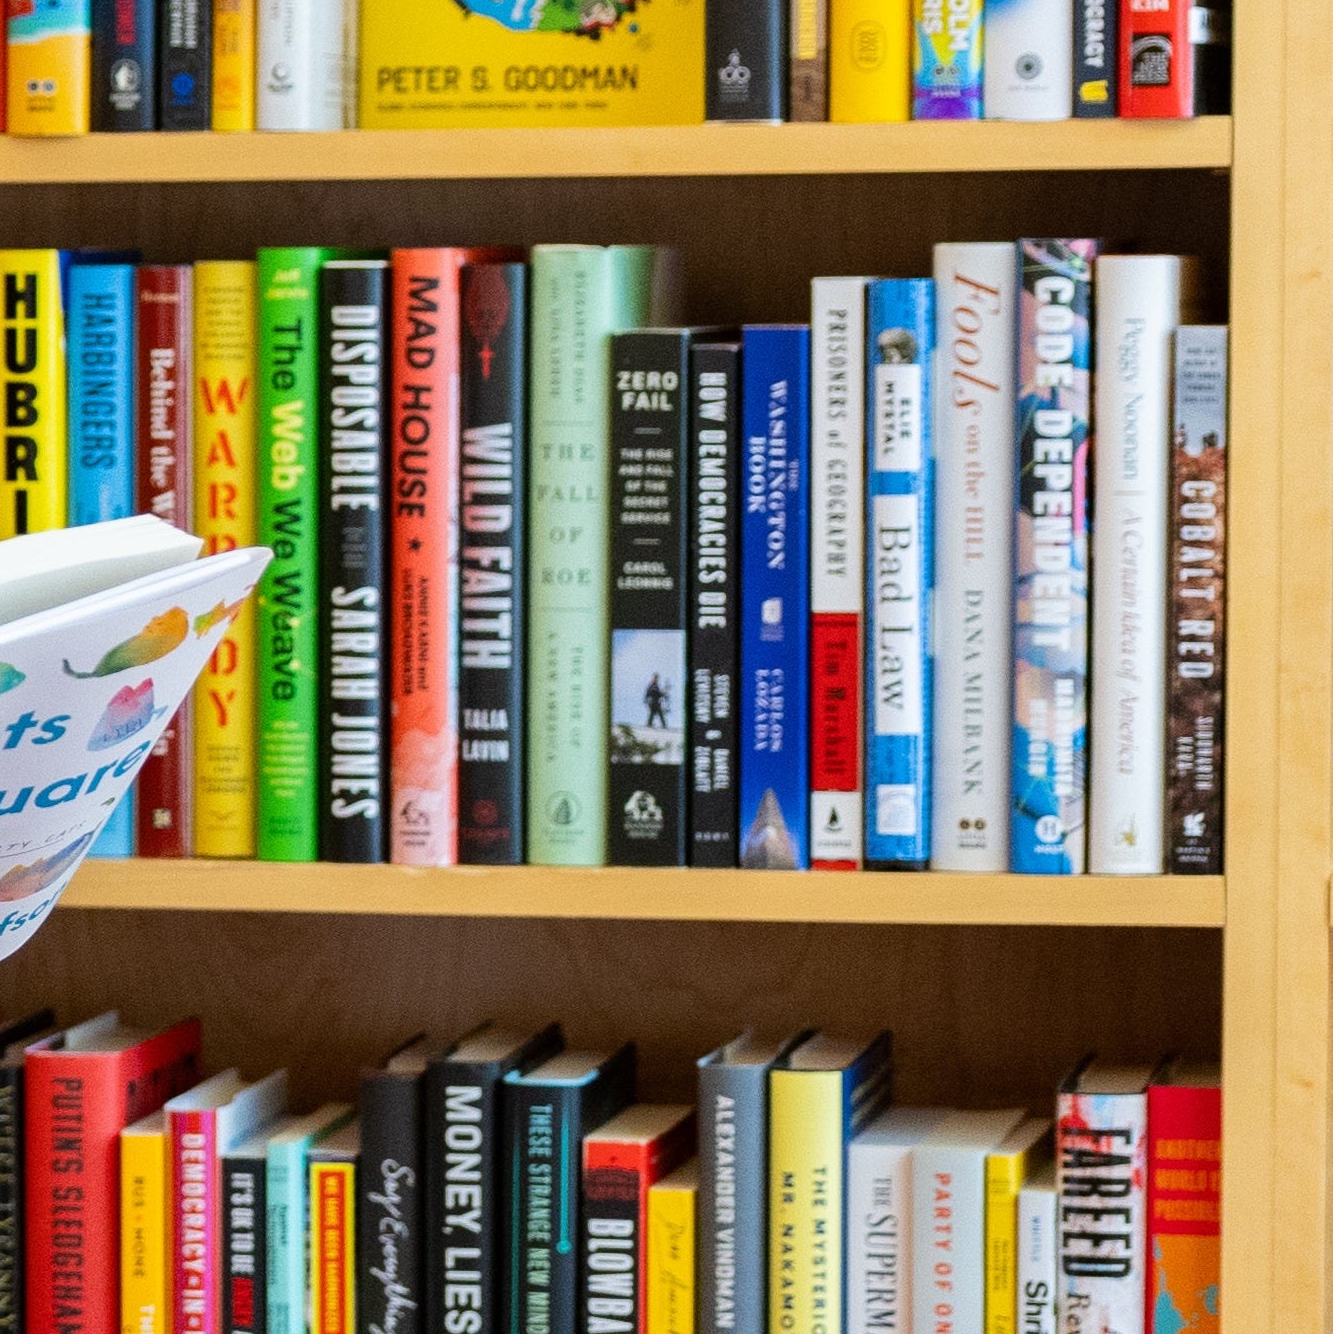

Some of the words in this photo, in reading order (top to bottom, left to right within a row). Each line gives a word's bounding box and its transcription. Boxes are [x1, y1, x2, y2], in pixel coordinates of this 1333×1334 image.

[378, 67, 463, 94] PETER
[472, 67, 496, 93] S.
[505, 65, 639, 91] GOODMAN
[274, 318, 302, 392] The
[406, 276, 438, 369] MAD
[5, 274, 38, 533] HUBRI
[82, 292, 115, 469] HARBINGERS
[331, 305, 378, 512] DISPOSABLE
[617, 371, 678, 392] ZERO
[622, 392, 672, 411] FAIL
[272, 399, 304, 491] Web
[400, 378, 433, 519] HOUSE
[463, 423, 513, 536] WILD
[272, 498, 304, 560] We
[878, 523, 914, 606] Bad
[1179, 479, 1215, 605] COBALT
[271, 566, 304, 700] Weave
[332, 586, 380, 708] SARAH
[461, 552, 513, 668] FAITH
[1180, 617, 1214, 679] RED
[878, 617, 914, 711] Law
[331, 713, 380, 819] JONES
[51, 1076, 84, 1173] PUTIN'S
[444, 1086, 483, 1235] MONEY,
[1061, 1128, 1131, 1279] FAREED
